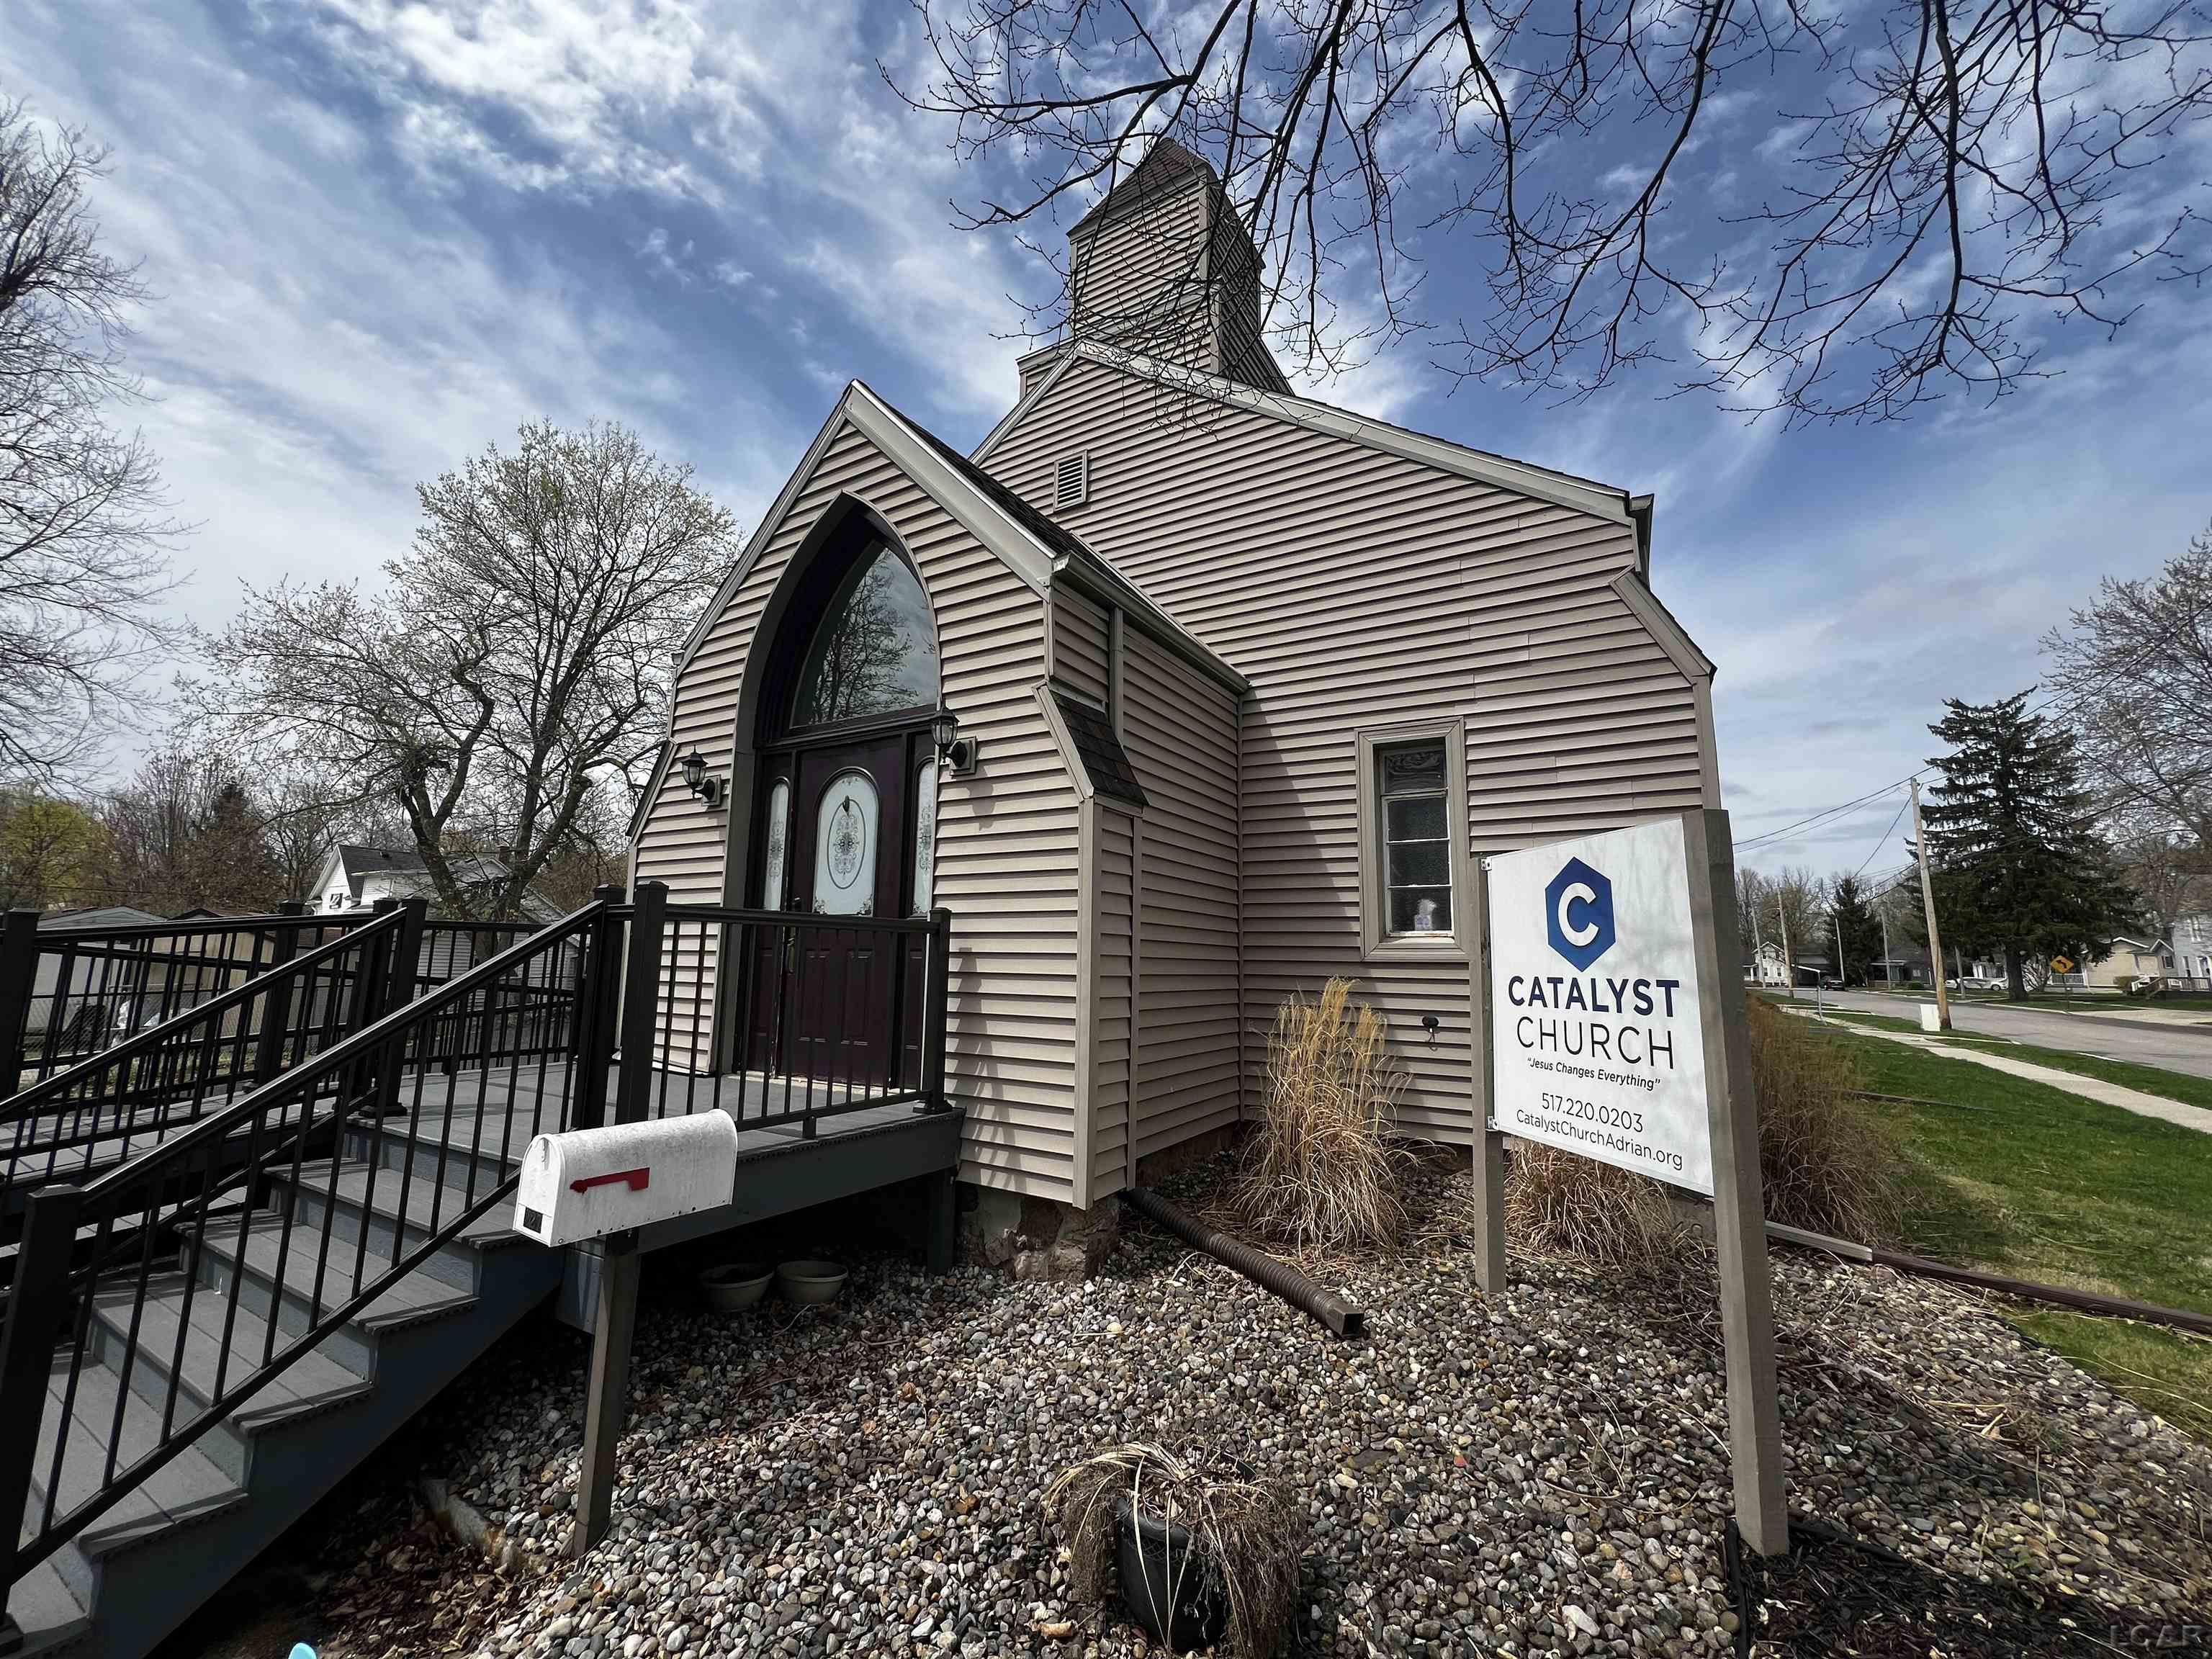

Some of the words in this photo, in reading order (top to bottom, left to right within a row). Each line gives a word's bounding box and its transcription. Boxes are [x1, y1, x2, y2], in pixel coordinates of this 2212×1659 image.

[1557, 882, 1600, 947] C
[1508, 975, 1680, 1017] CATALYST
[1516, 1016, 1674, 1069] CHURCH
[1555, 1061, 1595, 1078] Changes
[1541, 1092, 1644, 1133] 517.220.0203
[1516, 1109, 1683, 1171] CatalystChurchAdrian.org
